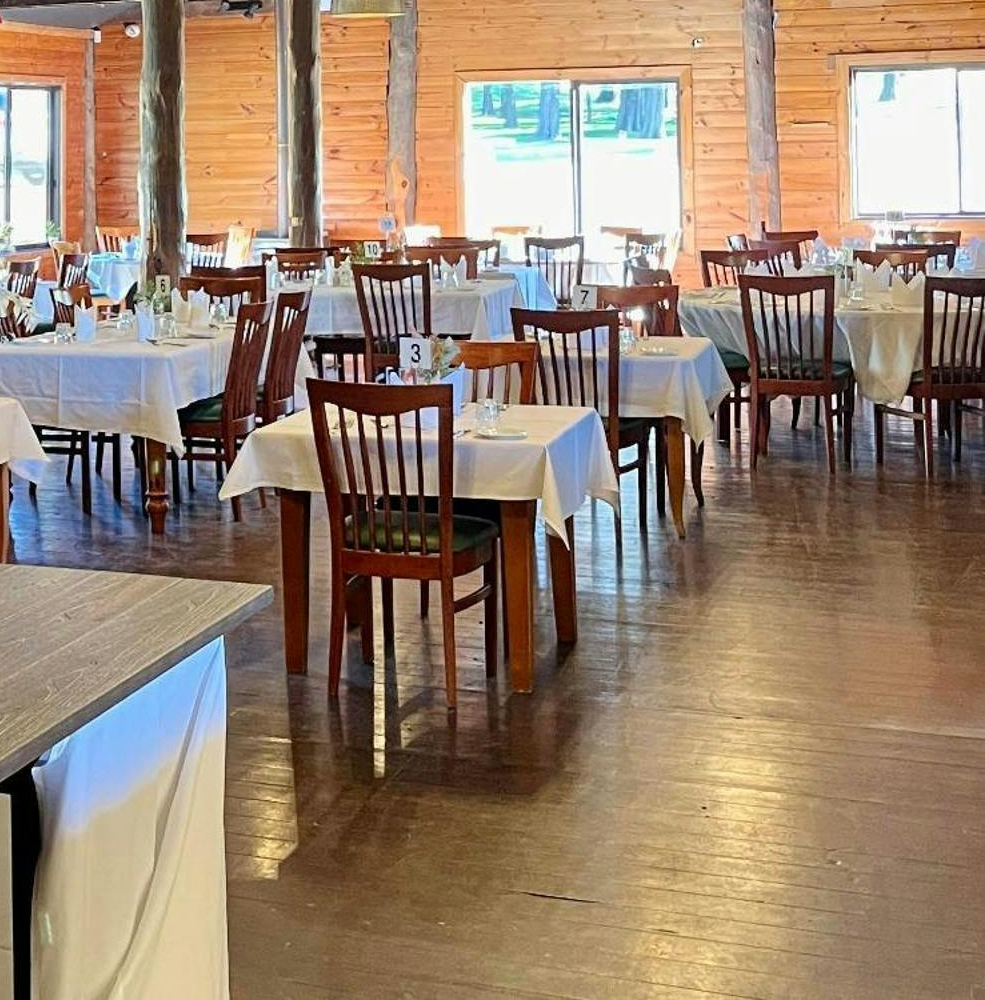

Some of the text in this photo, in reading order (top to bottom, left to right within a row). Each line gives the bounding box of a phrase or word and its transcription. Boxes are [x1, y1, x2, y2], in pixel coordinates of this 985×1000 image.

[367, 243, 378, 256] 10
[160, 278, 166, 293] 6
[580, 289, 589, 305] 7
[410, 343, 421, 363] 3
